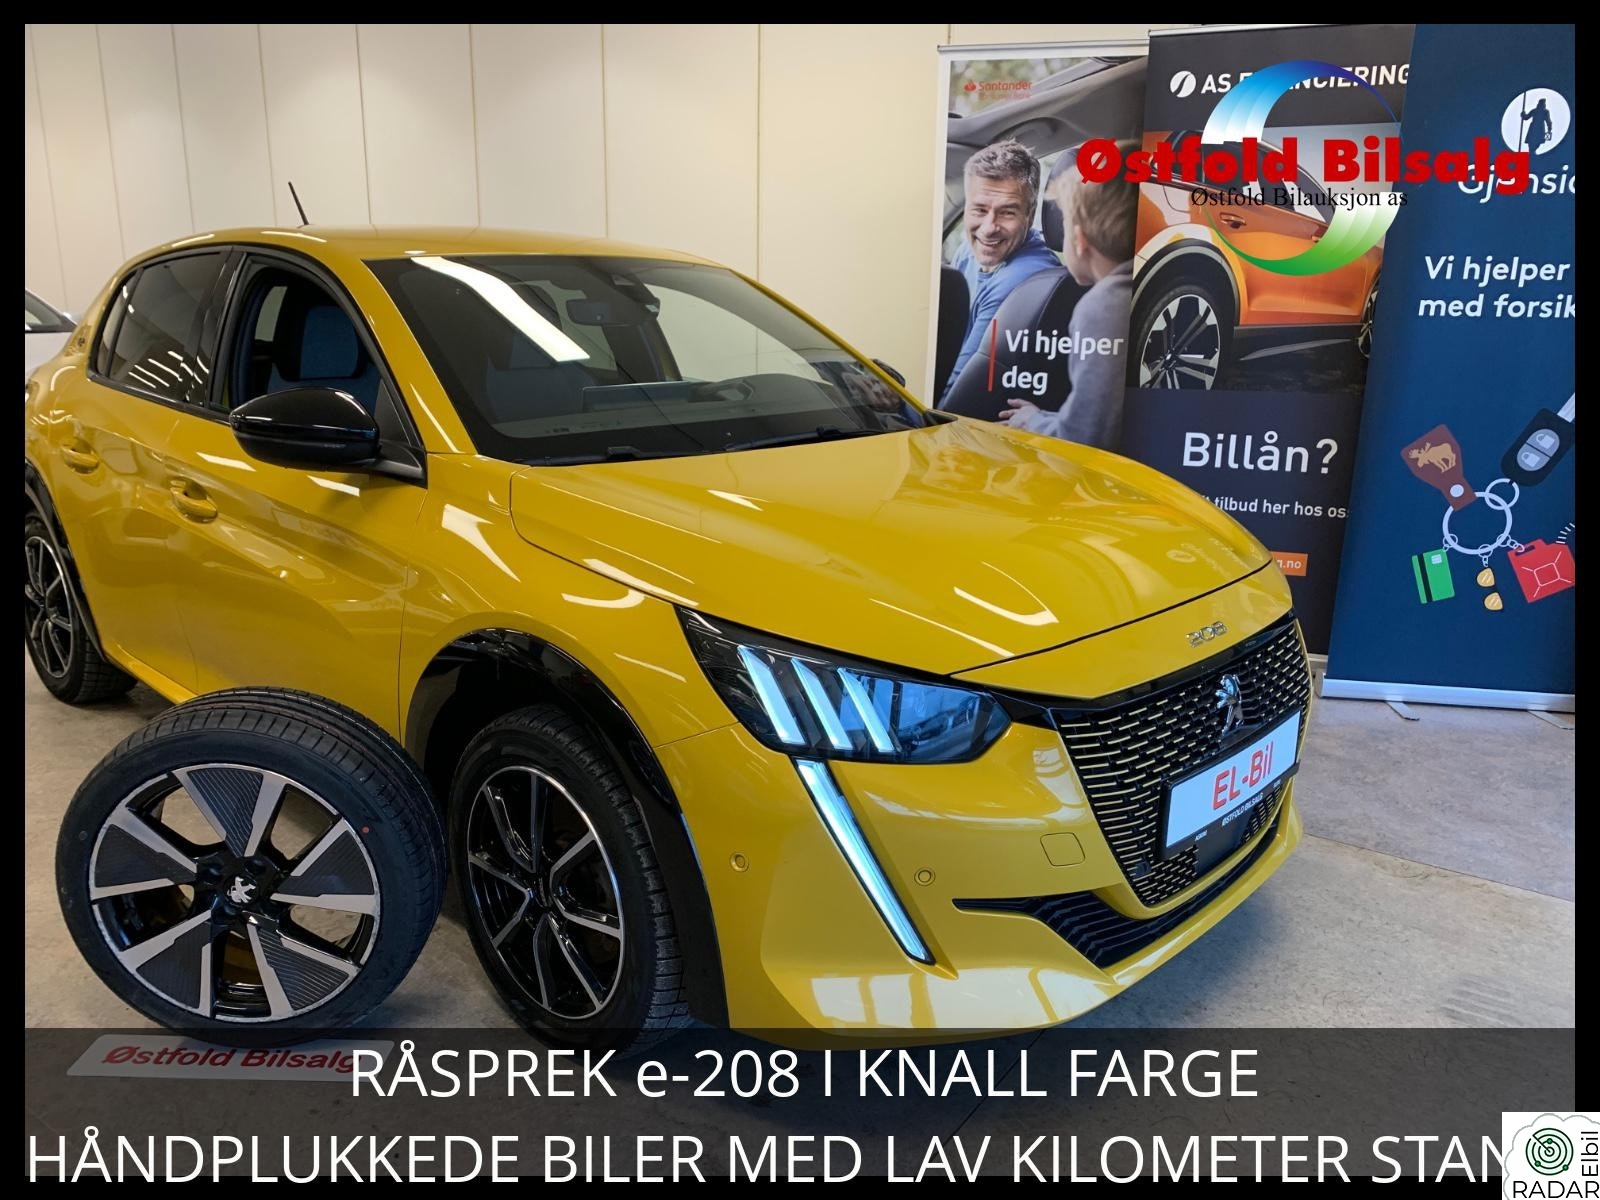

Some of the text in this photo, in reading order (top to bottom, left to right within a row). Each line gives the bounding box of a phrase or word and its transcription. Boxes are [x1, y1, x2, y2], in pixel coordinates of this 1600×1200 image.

[979, 81, 1033, 91] Santander
[1201, 74, 1231, 94] AS
[1425, 255, 1571, 288] Vi hjelper
[1418, 293, 1485, 317] med
[1005, 329, 1124, 360] Vi hjelper
[1002, 365, 1048, 396] deg
[1263, 499, 1290, 515] her
[1294, 501, 1323, 516] hos
[1185, 621, 1227, 648] 208
[1212, 740, 1274, 811] EL-Bil
[102, 1046, 361, 1074] Østfold Bilsalg
